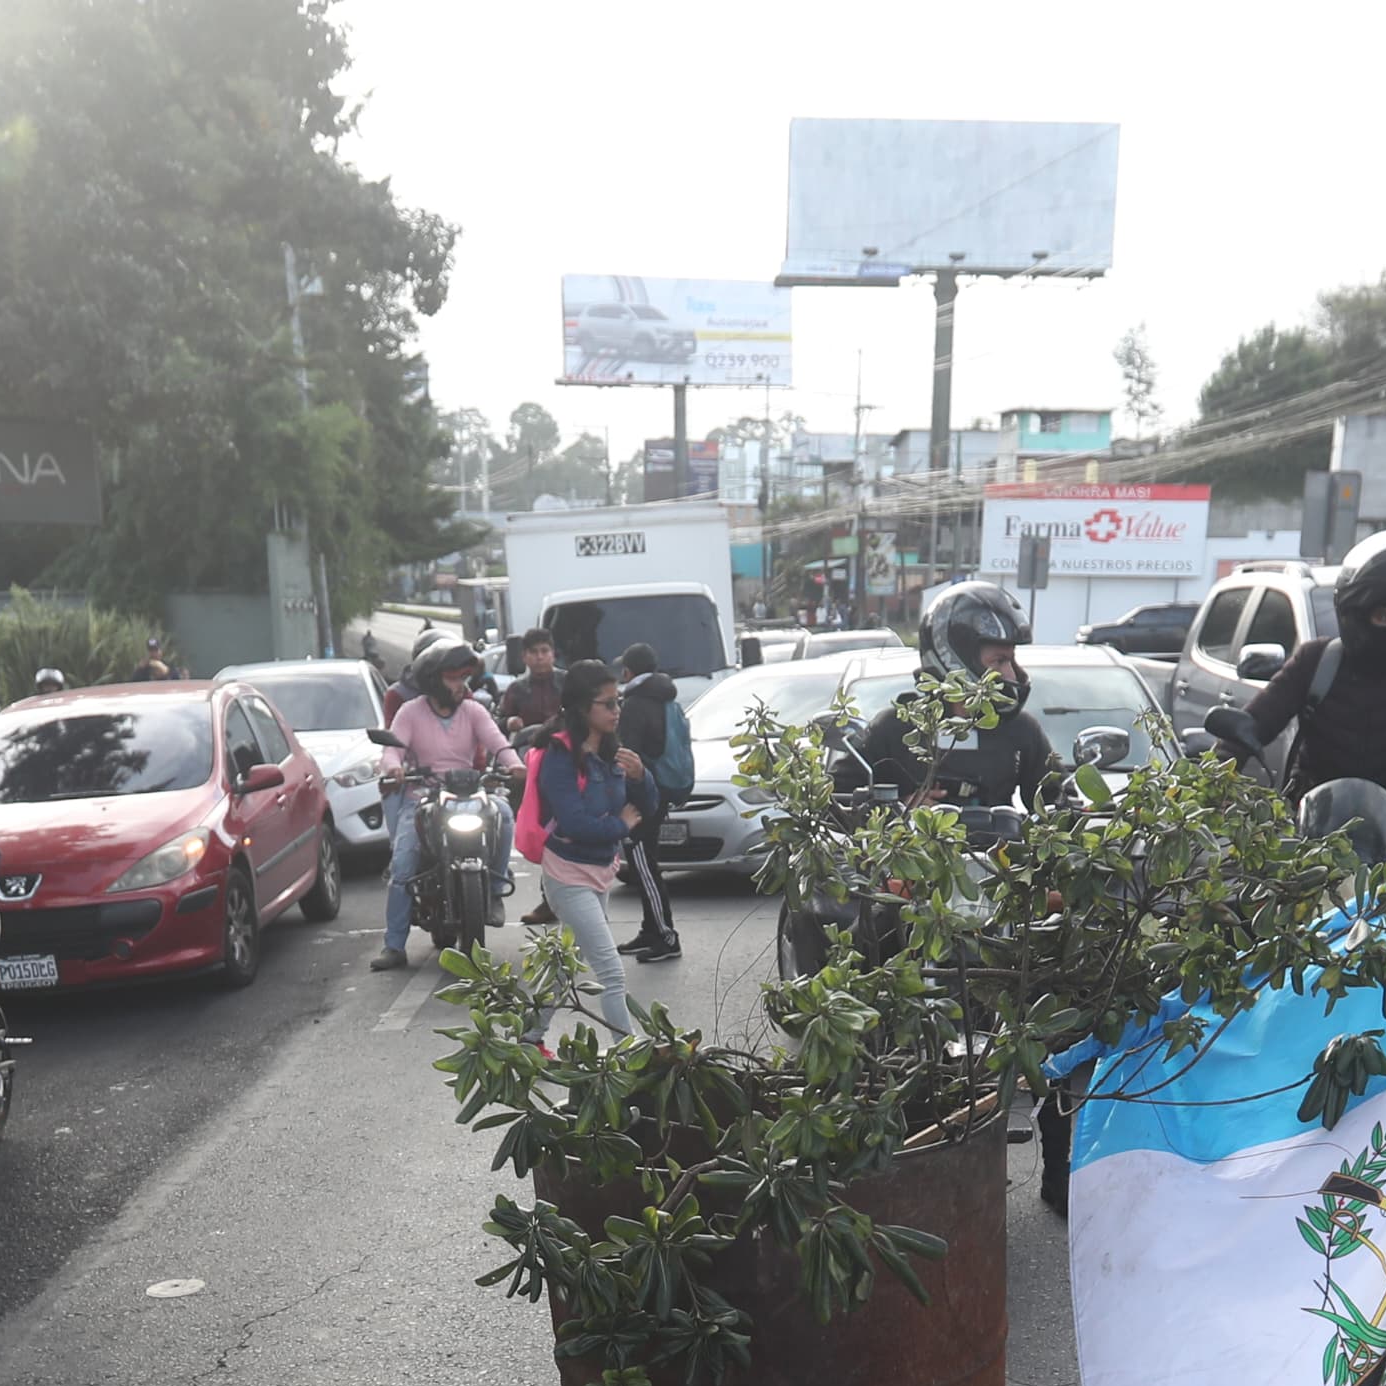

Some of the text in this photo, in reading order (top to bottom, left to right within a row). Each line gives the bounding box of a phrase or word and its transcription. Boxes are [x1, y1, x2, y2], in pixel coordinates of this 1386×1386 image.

[1004, 515, 1082, 538] Farma
[1063, 558, 1132, 570] NUESTROS
[1136, 559, 1193, 571] PRECIOS
